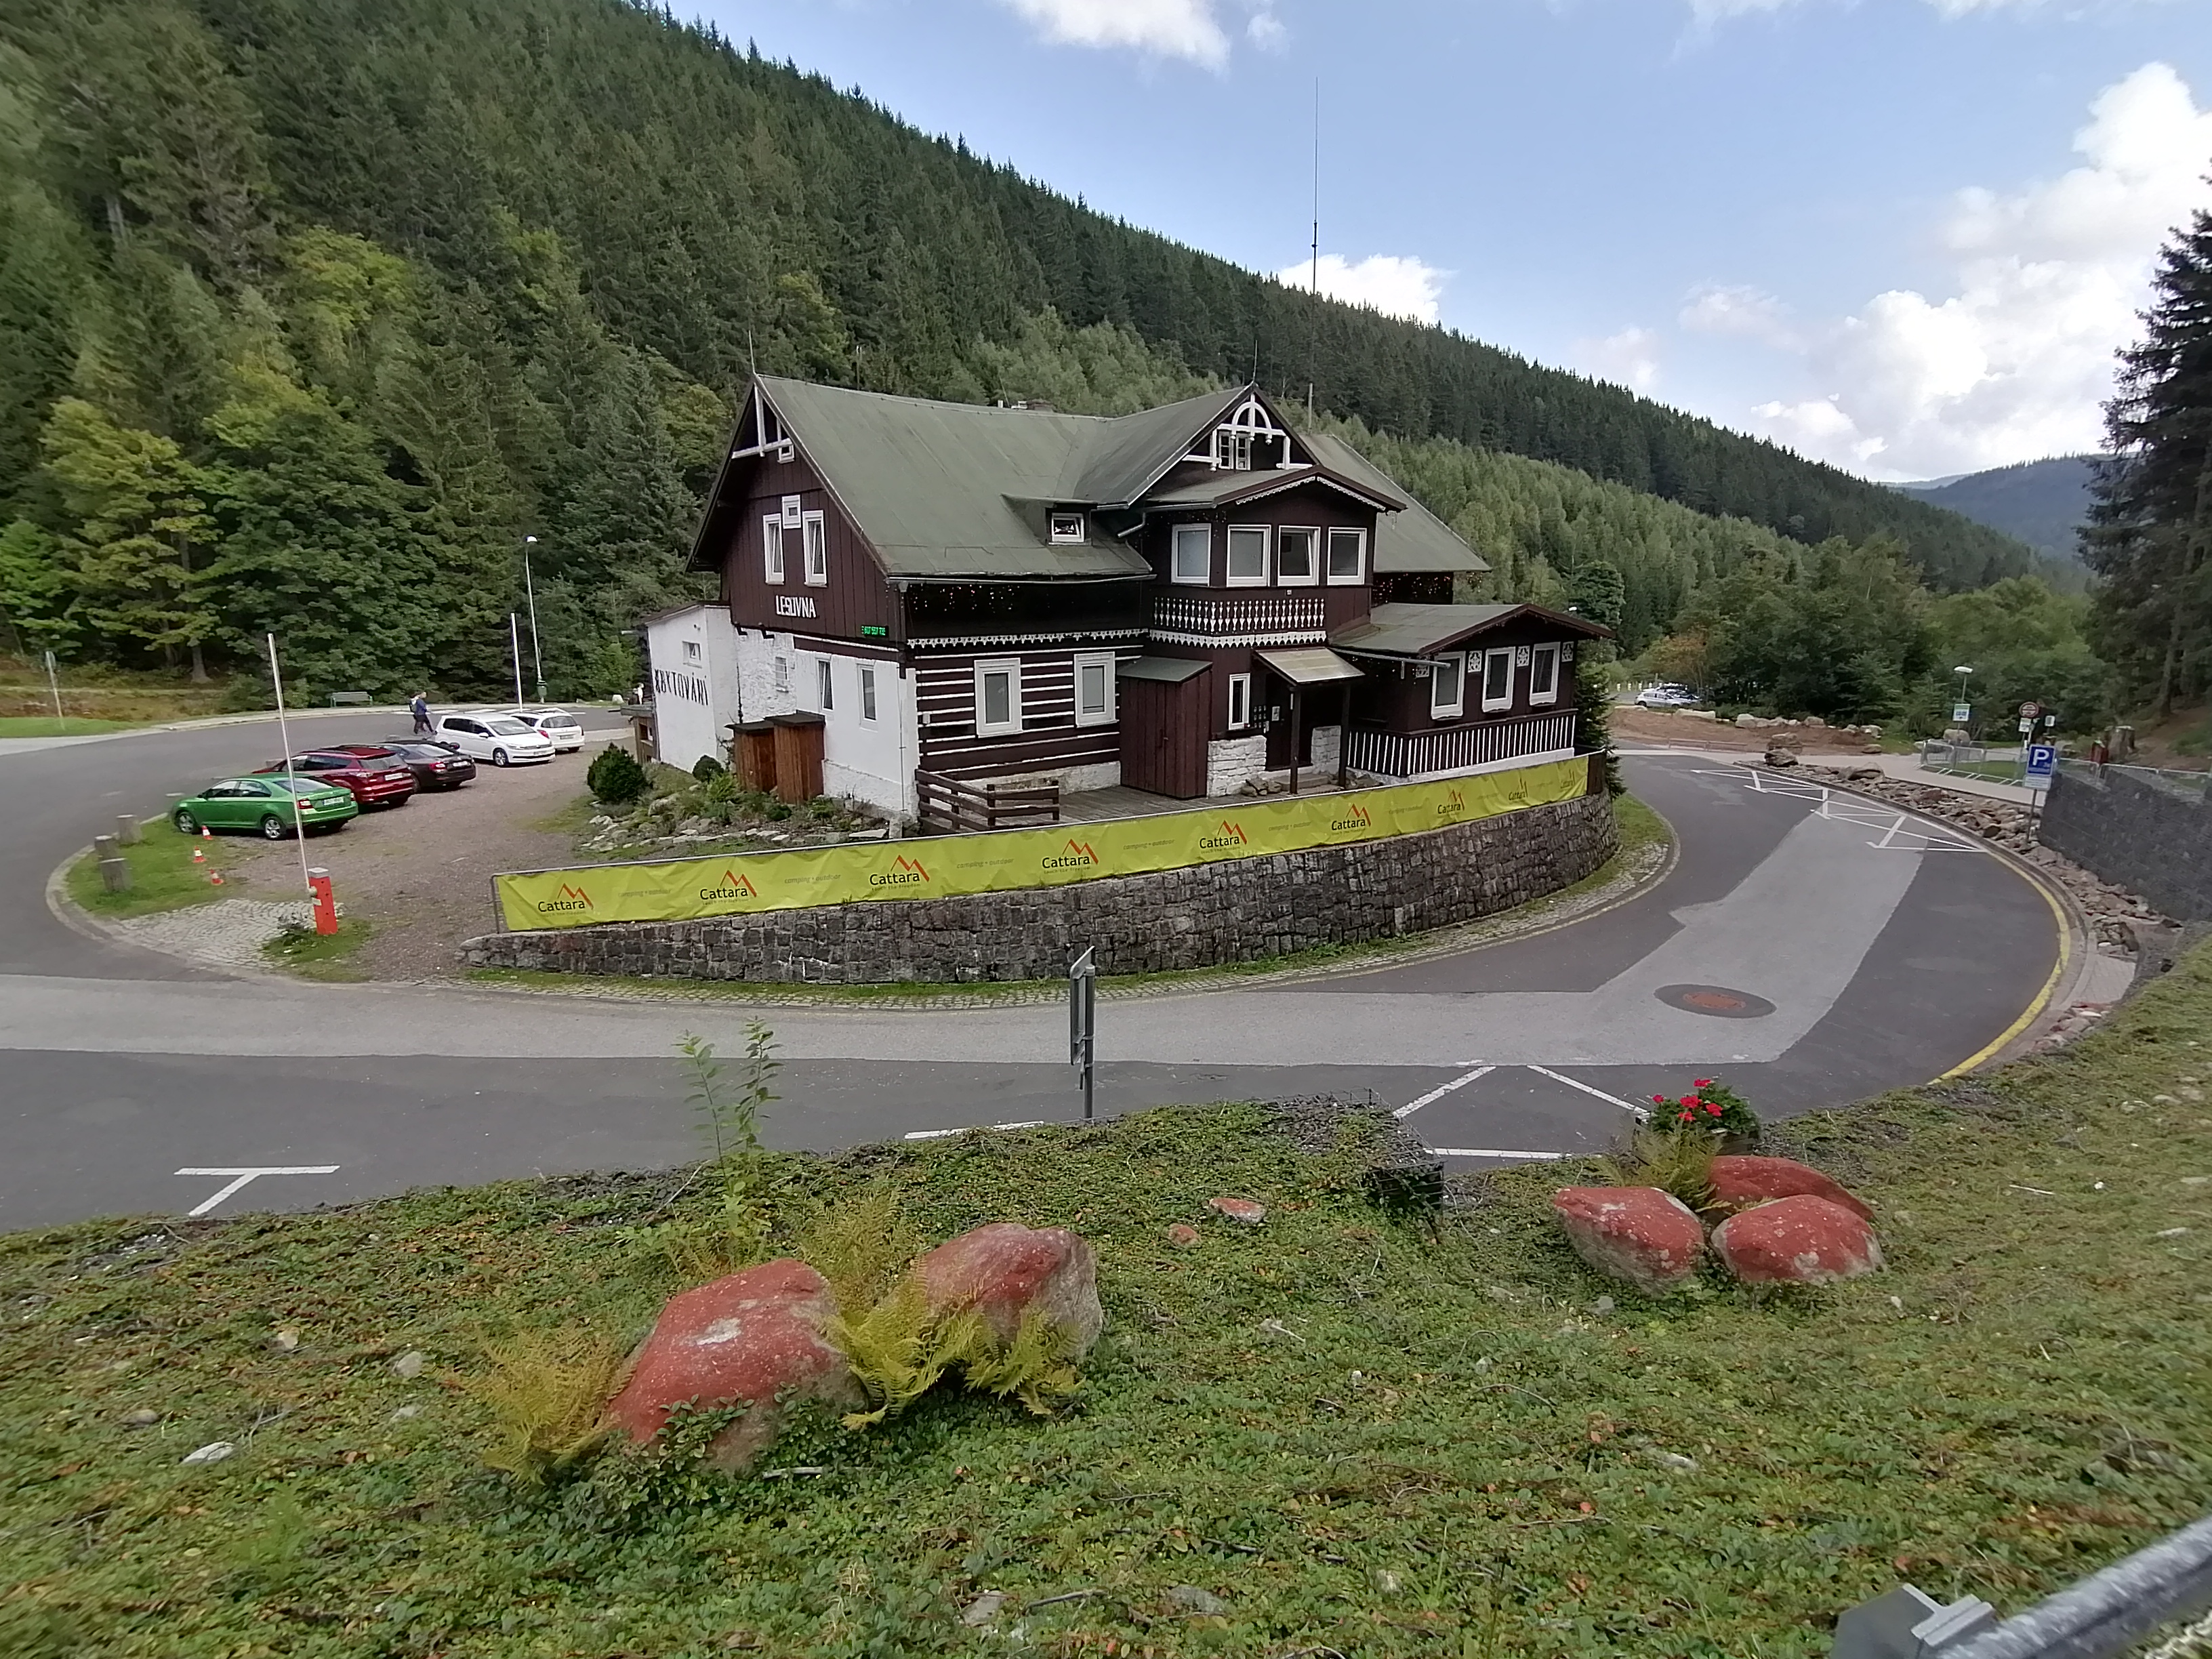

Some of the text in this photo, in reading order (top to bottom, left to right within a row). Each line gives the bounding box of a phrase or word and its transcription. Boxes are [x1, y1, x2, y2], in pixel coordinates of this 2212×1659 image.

[775, 595, 817, 618] LESOVNA
[2033, 749, 2049, 766] P
[1332, 819, 1366, 830] Cattara
[1200, 836, 1240, 848] Cattara
[1042, 856, 1090, 868] Cattara
[869, 873, 920, 885] Cattara
[700, 887, 748, 900] Cattara
[538, 900, 585, 912] Cattara
